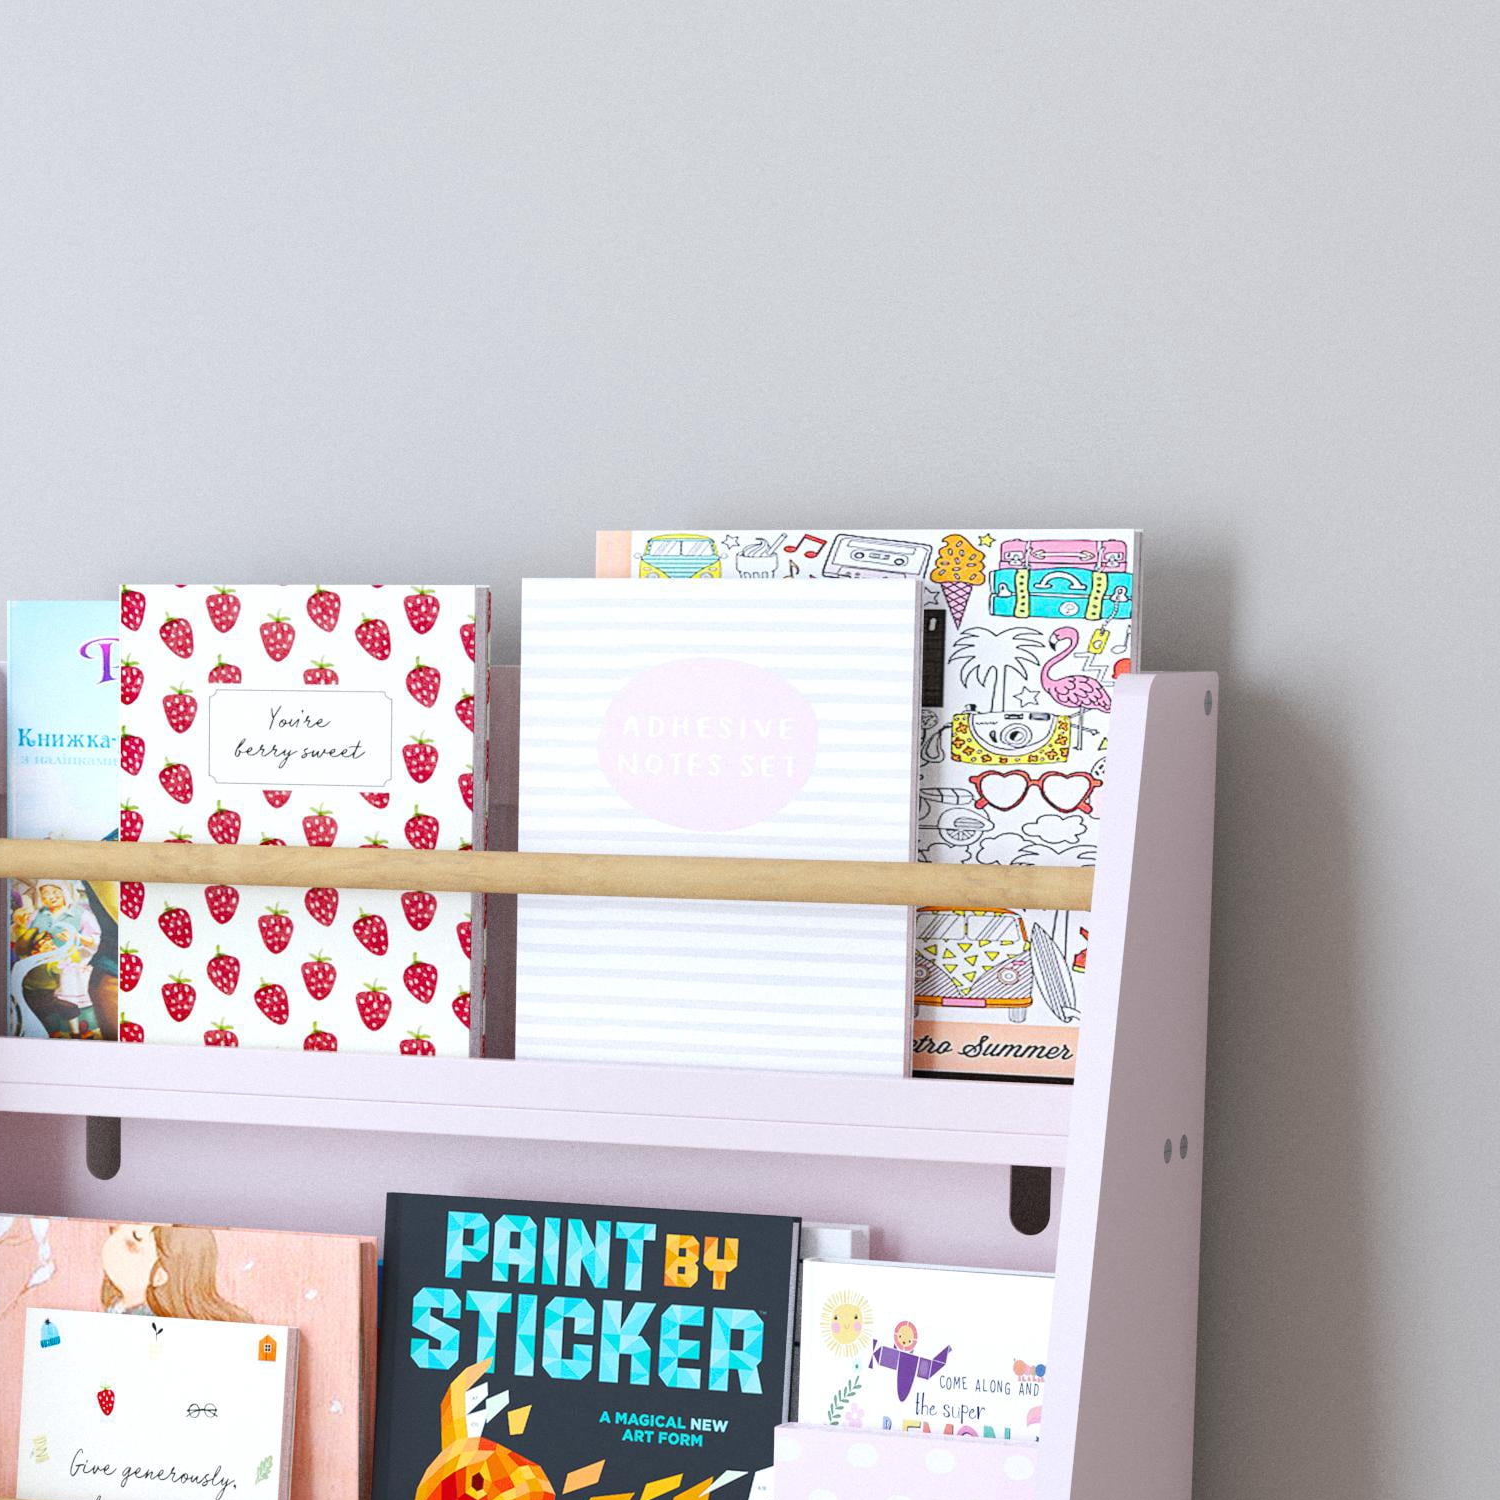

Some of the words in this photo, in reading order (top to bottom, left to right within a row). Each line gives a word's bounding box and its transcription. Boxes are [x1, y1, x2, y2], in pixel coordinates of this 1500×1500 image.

[268, 705, 331, 730] You're
[622, 715, 797, 741] ADHESIVE
[235, 738, 298, 769] berry
[300, 740, 366, 759] sweet
[617, 752, 722, 777] NOTES
[740, 754, 797, 778] SET
[912, 1034, 953, 1054] etro
[958, 1035, 1074, 1060] Summer
[444, 1210, 657, 1292] PAINT
[664, 1232, 739, 1291] BY
[410, 1286, 765, 1395] STICKER
[939, 1375, 968, 1391] COME
[975, 1379, 1011, 1396] ALONG
[1018, 1383, 1040, 1397] AND
[915, 1392, 937, 1416] the
[943, 1404, 986, 1424] super
[599, 1410, 611, 1424] A
[615, 1412, 687, 1430] MAGICAL
[690, 1417, 729, 1433] NEW
[622, 1428, 654, 1444] ART
[658, 1431, 704, 1448] FORM
[69, 1448, 117, 1477] Give
